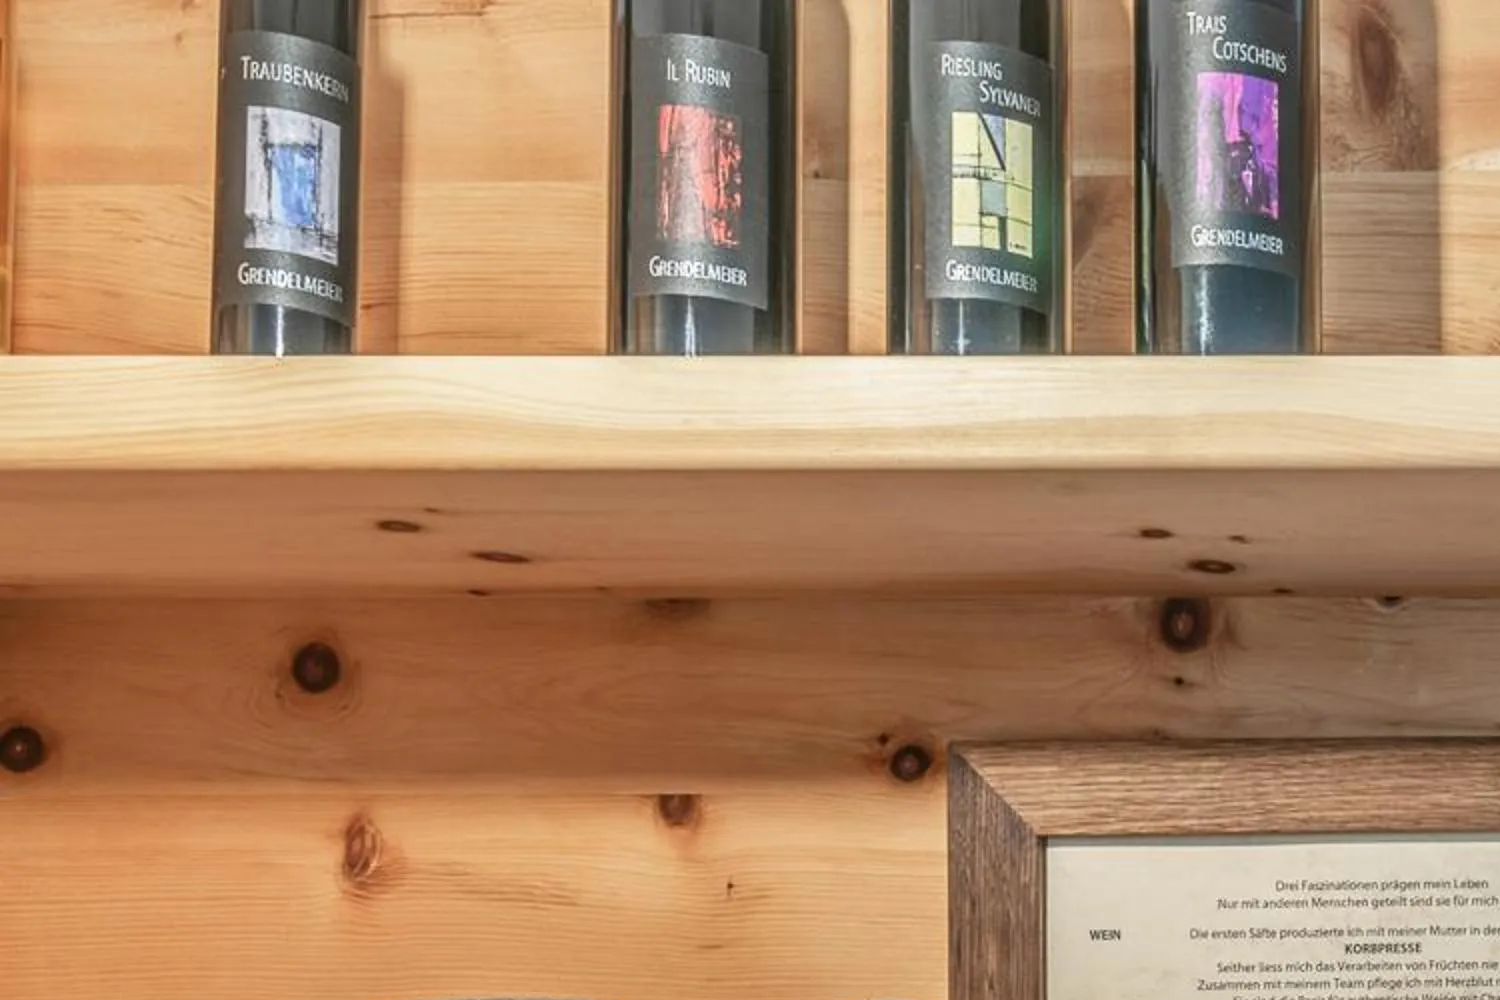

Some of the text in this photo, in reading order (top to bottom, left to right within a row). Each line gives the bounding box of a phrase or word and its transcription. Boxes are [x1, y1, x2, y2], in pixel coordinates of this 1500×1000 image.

[1186, 11, 1227, 35] TRAIS
[941, 53, 1003, 81] RIESLING
[1213, 36, 1287, 73] COTSCHENS
[667, 58, 731, 89] IL RUBIN
[980, 80, 1041, 117] SYLVANER
[1191, 224, 1284, 255] GRENDELMEIER
[237, 261, 343, 304] GRENDELMEIER
[649, 255, 748, 287] GRENDELMEIER
[945, 259, 1038, 293] GRENDELMEIER
[1218, 897, 1238, 909] Nur
[1241, 897, 1260, 909] mit
[1263, 897, 1309, 908] anderen
[1312, 896, 1369, 908] Menschen
[1410, 895, 1433, 907] sind
[1436, 895, 1451, 907] sie
[1453, 895, 1469, 907] für
[1472, 895, 1499, 907] mich
[1089, 929, 1121, 941] WEIN
[1345, 942, 1422, 954] KORBPRESSE
[1218, 961, 1255, 973] Seither
[1286, 961, 1313, 972] mich
[1316, 960, 1336, 972] das
[1337, 960, 1402, 972] Verarbeiten
[1406, 962, 1427, 971] von
[1429, 959, 1479, 971] Früchten
[1482, 959, 1499, 971] nie
[1198, 978, 1261, 990] Zusammen
[1264, 978, 1282, 989] mit
[1284, 977, 1331, 989] meinem
[1334, 977, 1365, 989] Team
[1368, 977, 1403, 992] pflege
[1405, 977, 1422, 988] ich
[1425, 976, 1443, 988] mit
